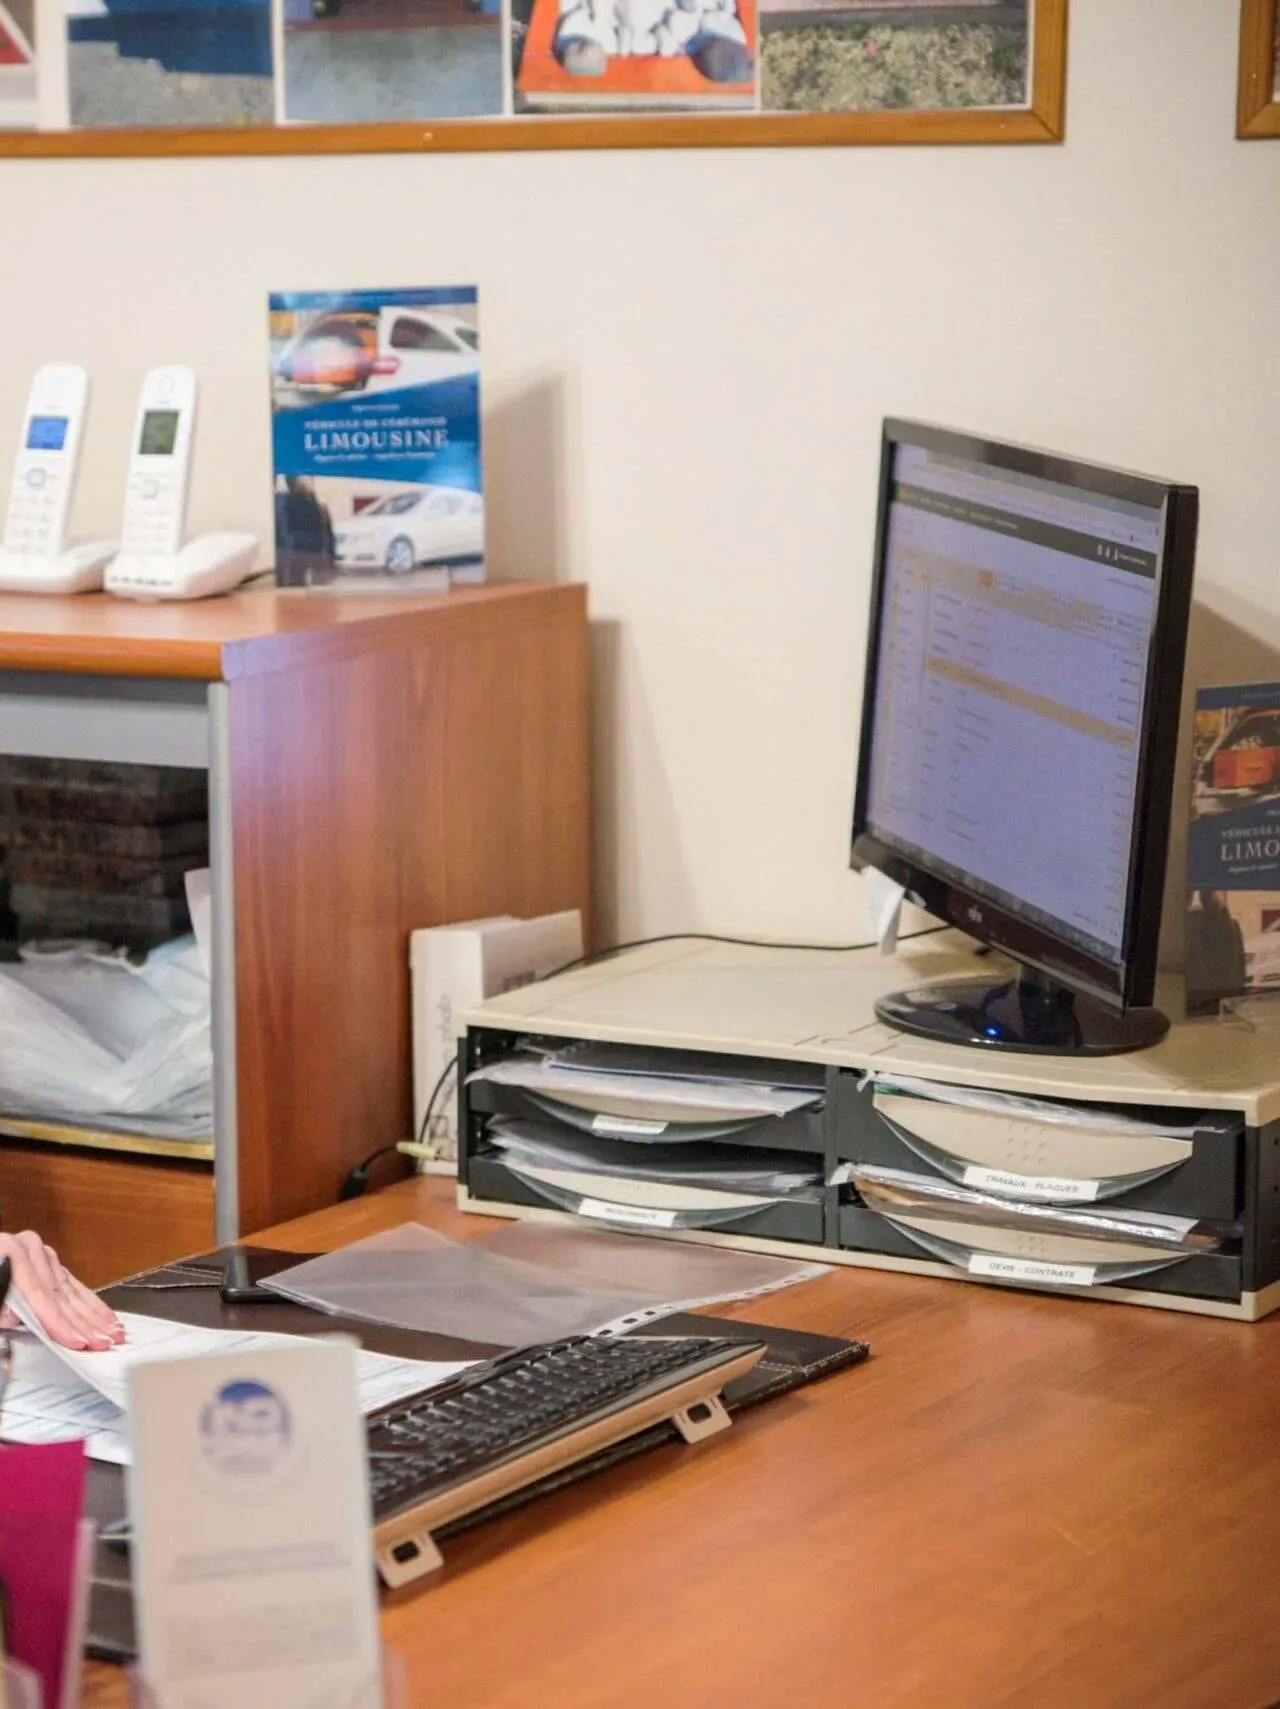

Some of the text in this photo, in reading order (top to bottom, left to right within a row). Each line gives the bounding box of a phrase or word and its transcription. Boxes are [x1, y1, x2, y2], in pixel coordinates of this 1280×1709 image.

[304, 429, 448, 451] LIMOUSINE
[985, 1175, 1026, 1188] TRAVAUX
[1034, 1182, 1079, 1193] PLAQUES
[1024, 1267, 1075, 1278] CONTRATS
